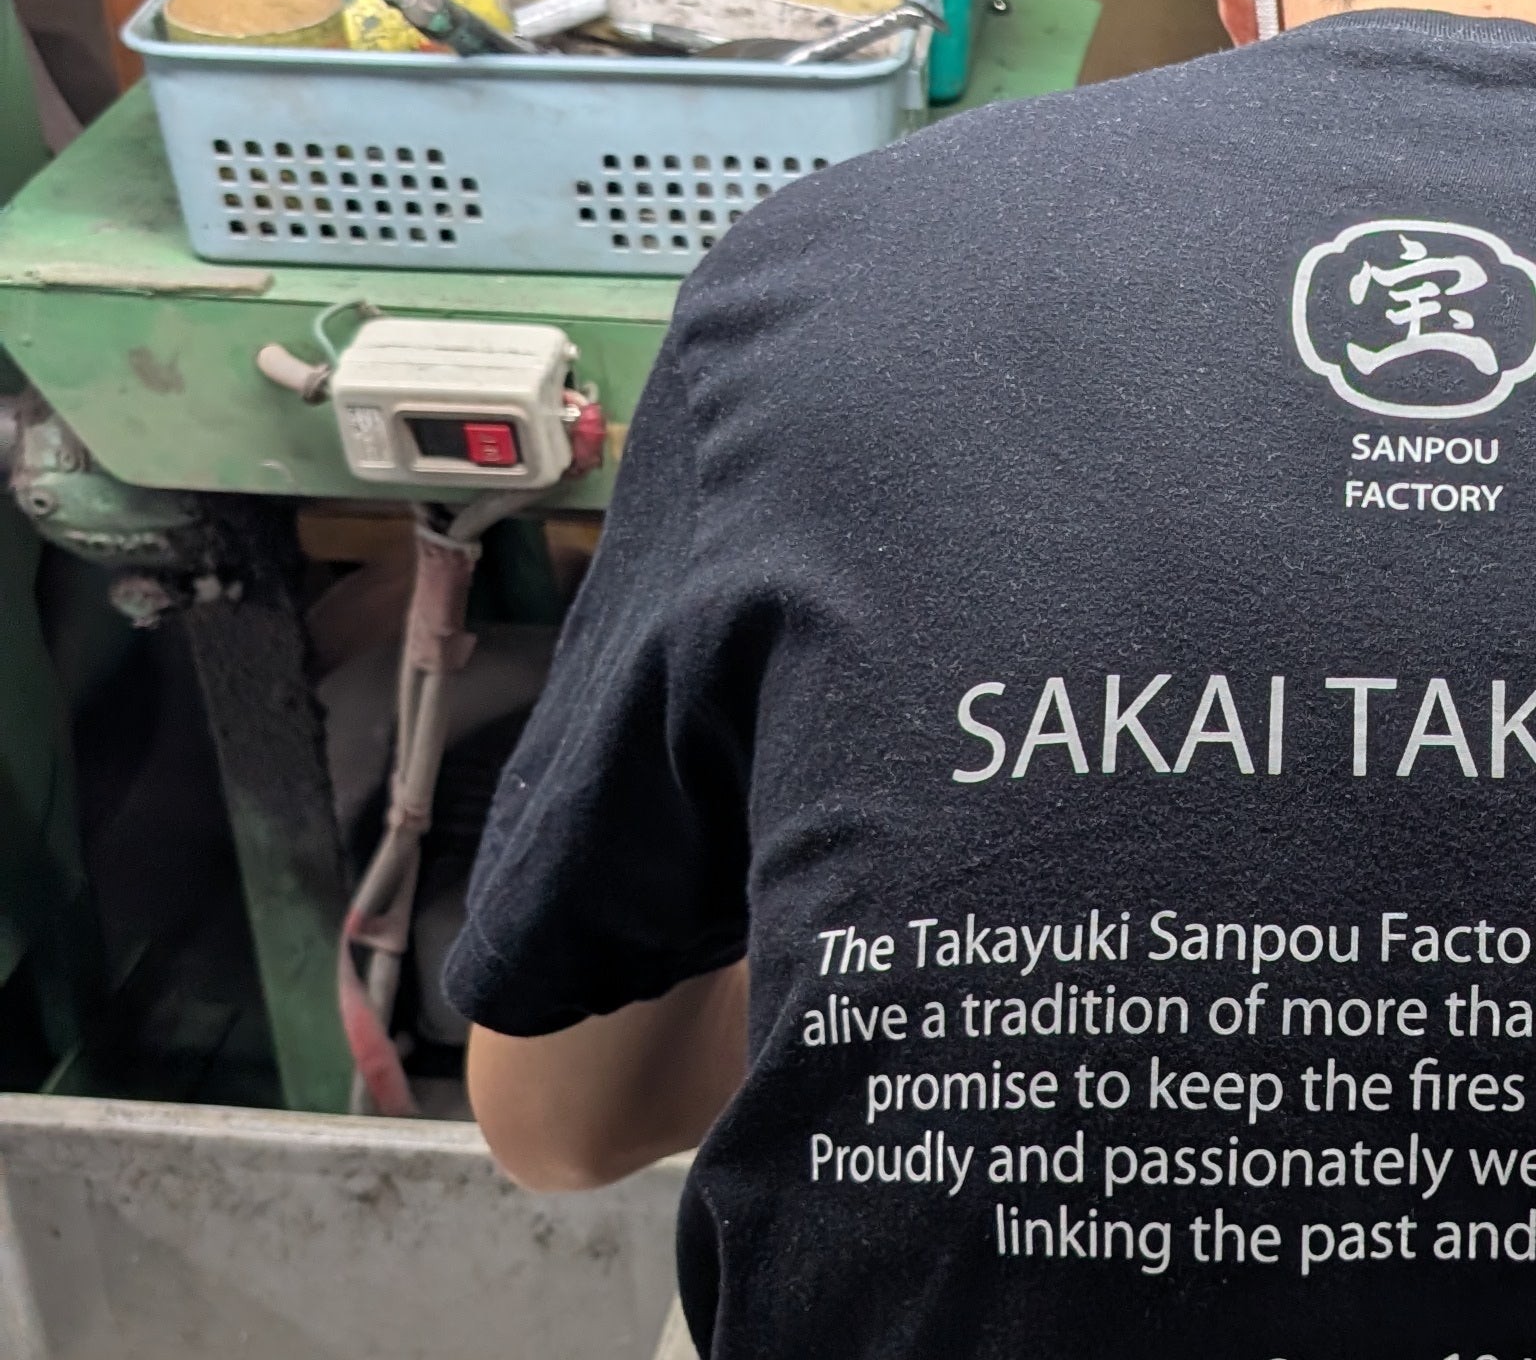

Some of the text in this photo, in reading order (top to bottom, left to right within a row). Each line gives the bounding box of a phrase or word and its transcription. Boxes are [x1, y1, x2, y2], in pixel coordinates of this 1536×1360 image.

[1346, 231, 1503, 379] 宝
[1350, 432, 1499, 465] SANPOU
[1344, 479, 1504, 513] FACTORY
[951, 673, 1285, 784] SAKAI
[817, 925, 895, 976] The
[907, 908, 1131, 977] Takayuki
[1148, 909, 1360, 975] Sanpou
[803, 993, 908, 1047] alive
[921, 1001, 946, 1039] a
[961, 981, 1189, 1038] tradition
[1208, 982, 1269, 1036] of
[1281, 997, 1428, 1037] more
[867, 1070, 1059, 1124] promise
[1074, 1064, 1131, 1109] to
[1149, 1055, 1284, 1125] keep
[1300, 1057, 1393, 1112] the
[1409, 1056, 1525, 1112] fires
[811, 1129, 975, 1196] Proudly
[988, 1129, 1084, 1183] and
[1105, 1132, 1454, 1200] passionately
[996, 1203, 1171, 1274] linking
[1189, 1207, 1282, 1263] the
[1301, 1215, 1418, 1276] past
